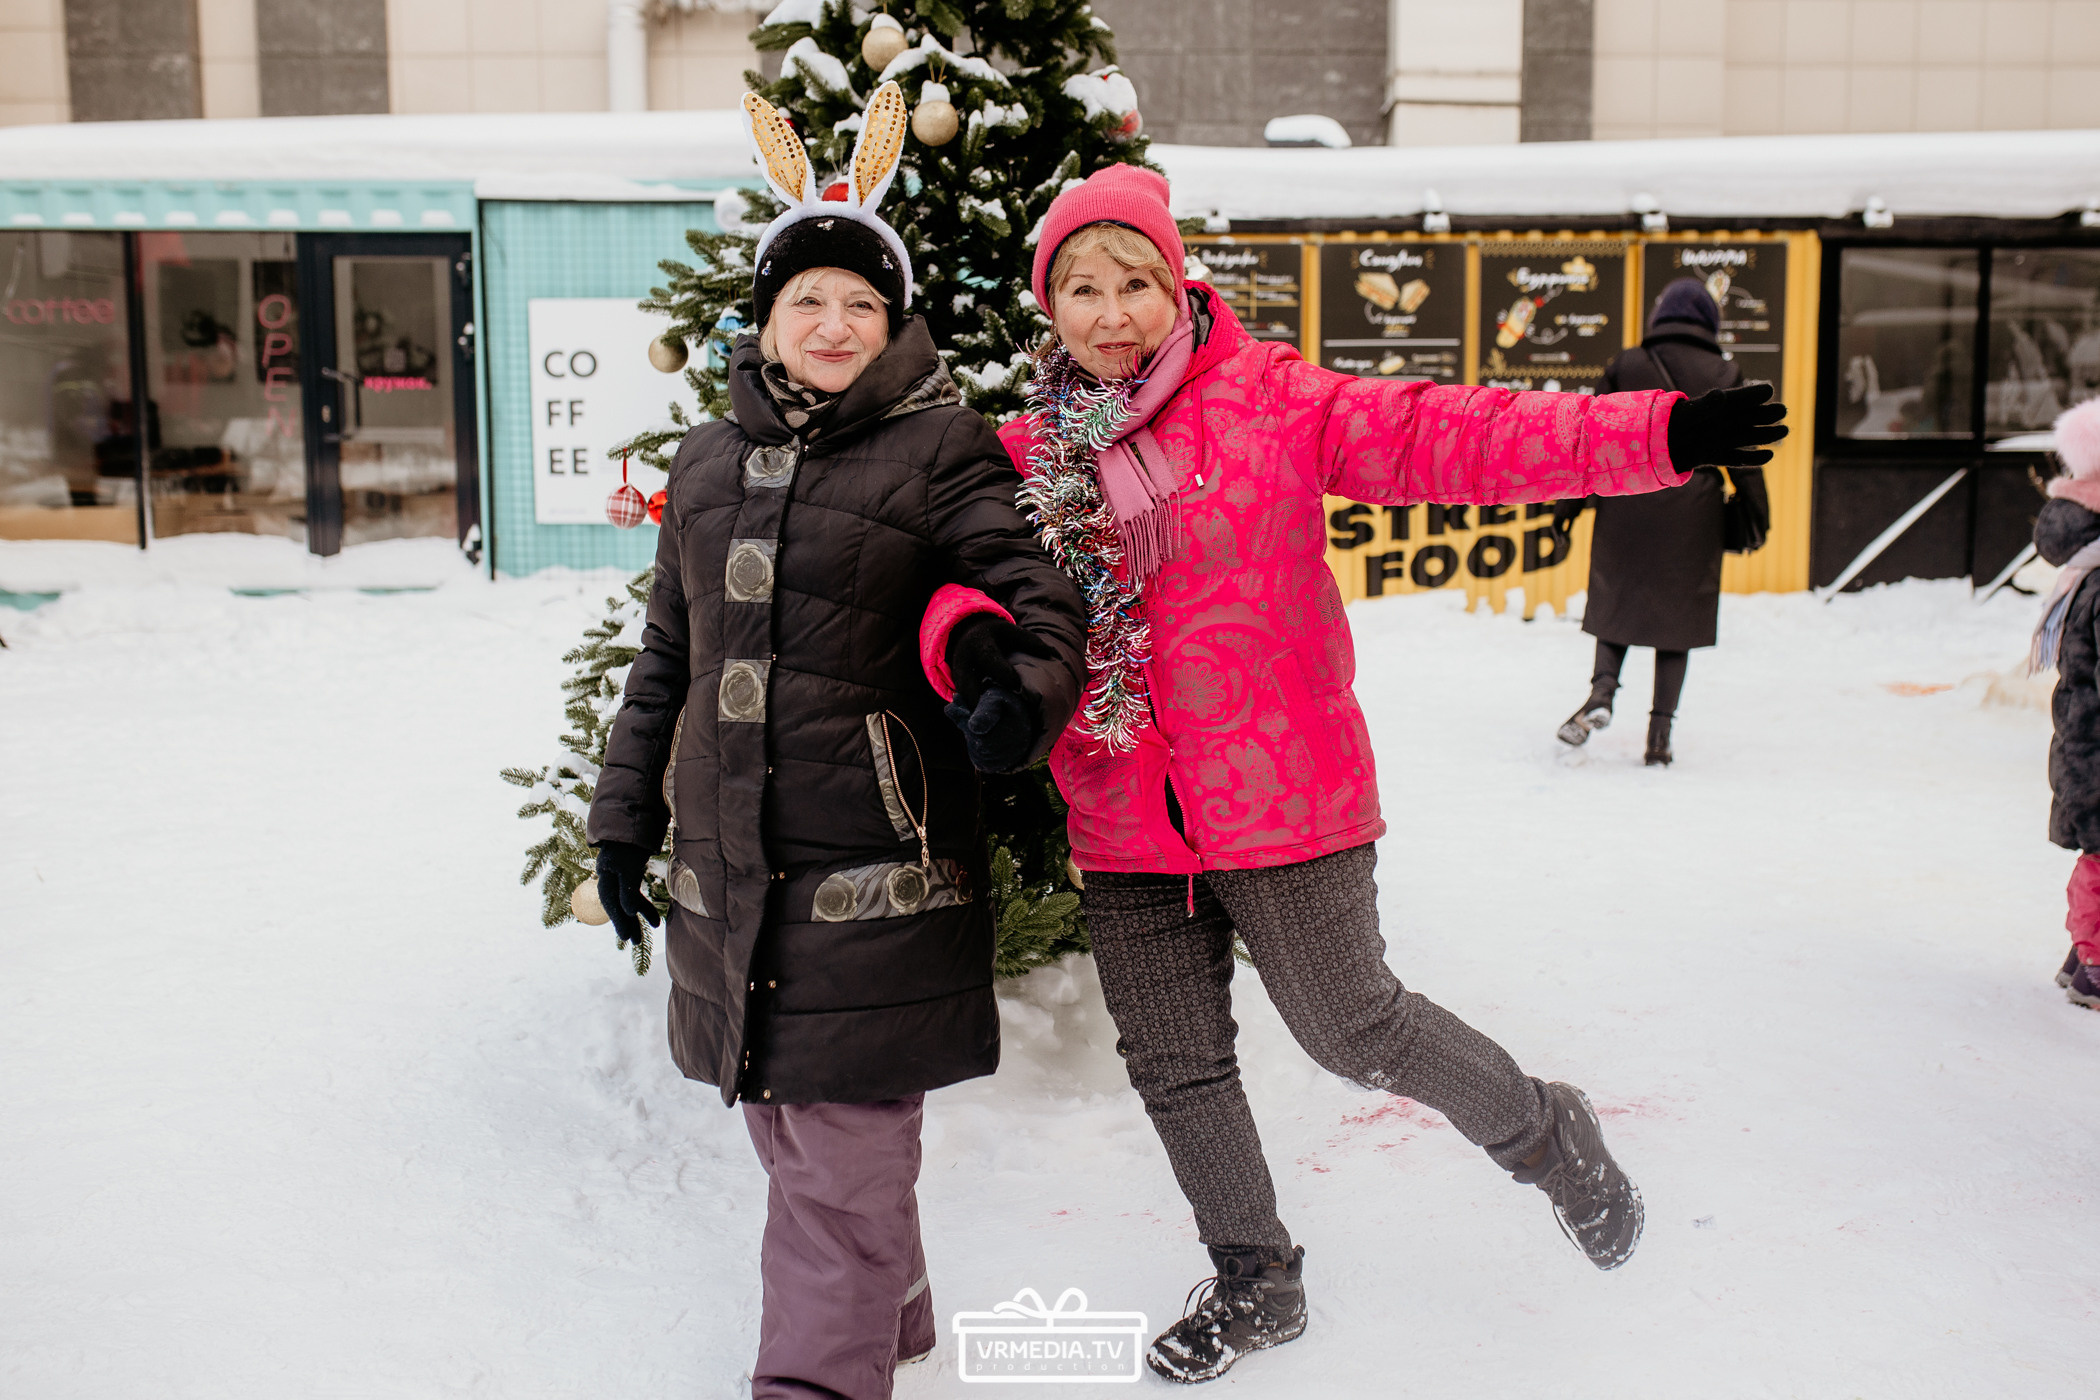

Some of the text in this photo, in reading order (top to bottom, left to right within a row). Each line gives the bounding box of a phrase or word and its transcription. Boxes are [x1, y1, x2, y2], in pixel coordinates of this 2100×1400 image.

[257, 293, 297, 438] OPEN
[545, 351, 597, 378] CO
[547, 400, 584, 426] FF
[549, 448, 588, 475] EE
[1365, 526, 1572, 598] FOOD
